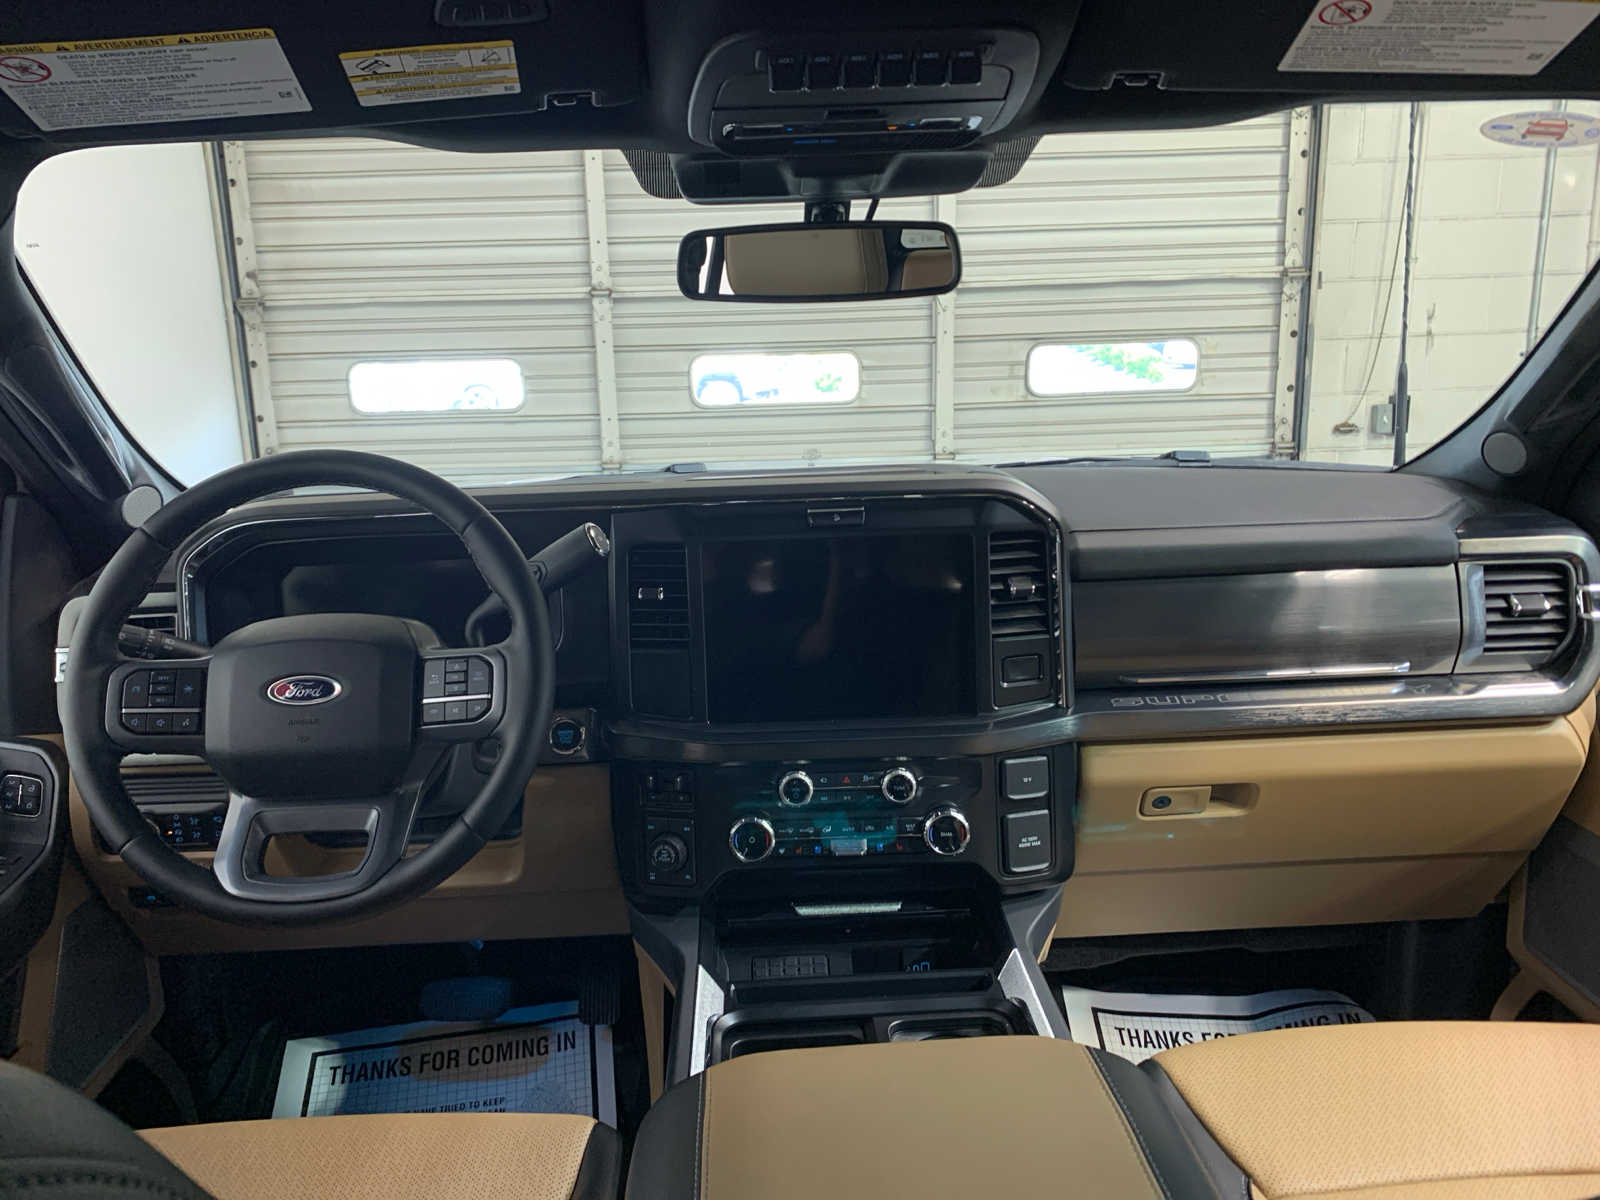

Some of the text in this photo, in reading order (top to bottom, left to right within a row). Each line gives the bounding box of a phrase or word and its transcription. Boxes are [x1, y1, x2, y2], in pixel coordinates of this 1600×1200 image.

[194, 30, 271, 43] ADVERTENCIA
[285, 681, 322, 699] Ford
[1114, 1026, 1194, 1050] THANKS
[329, 1031, 576, 1086] THANKS FOR COMING IN
[469, 1100, 480, 1109] TO
